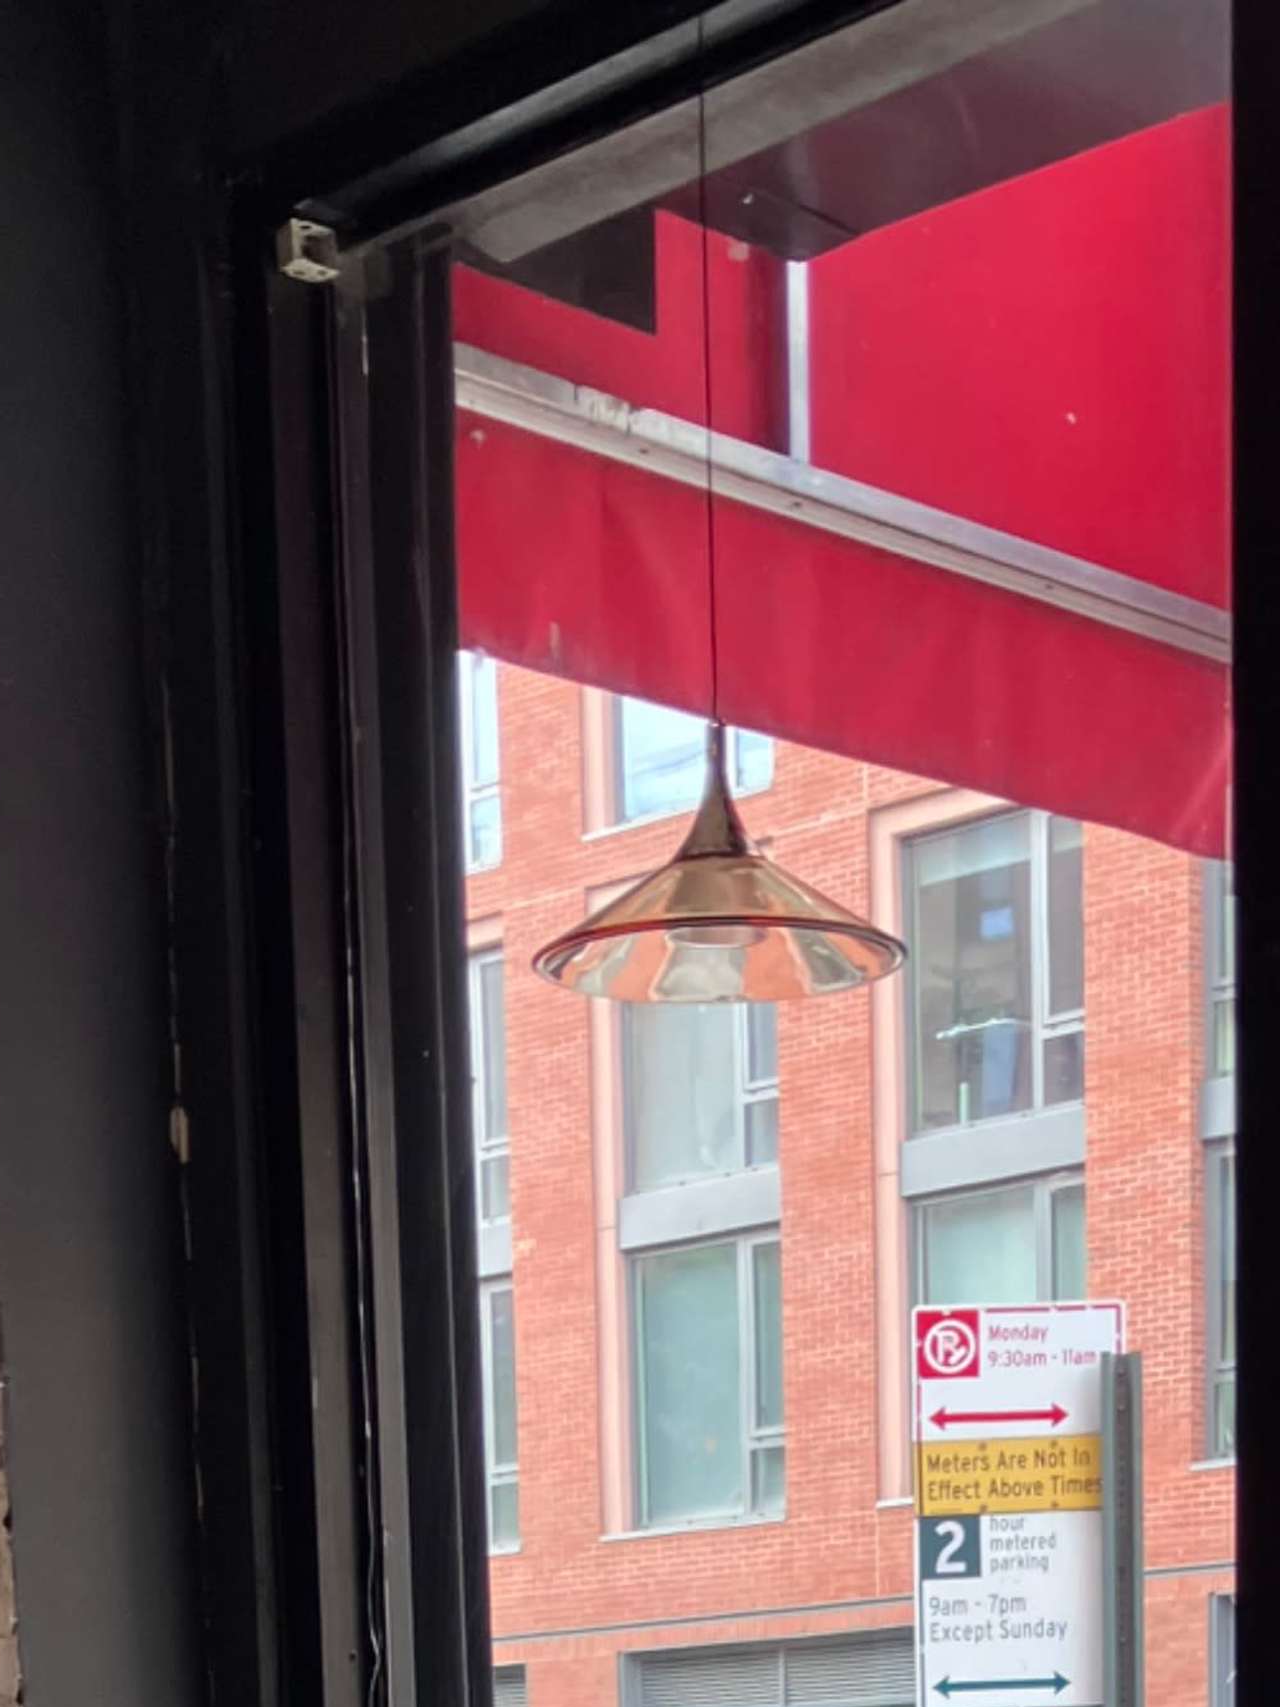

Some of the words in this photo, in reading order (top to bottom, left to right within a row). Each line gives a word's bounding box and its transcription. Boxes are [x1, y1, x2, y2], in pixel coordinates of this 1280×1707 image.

[988, 1325, 1048, 1344] Monday
[987, 1351, 1048, 1367] 9:30am
[1062, 1350, 1098, 1366] 11am
[927, 1453, 991, 1473] Meters
[997, 1451, 1028, 1470] Are
[1034, 1449, 1067, 1468] Not
[1074, 1448, 1091, 1465] In
[928, 1480, 981, 1500] Effect
[988, 1479, 1044, 1498] Above
[1052, 1475, 1104, 1495] Times
[990, 1516, 1025, 1532] hour
[935, 1520, 966, 1574] 2
[990, 1533, 1057, 1551] metered
[990, 1554, 1050, 1573] parking
[929, 1596, 969, 1616] 9am
[988, 1594, 1028, 1617] 7pm
[930, 1620, 993, 1643] Except
[999, 1618, 1068, 1641] Sunday
